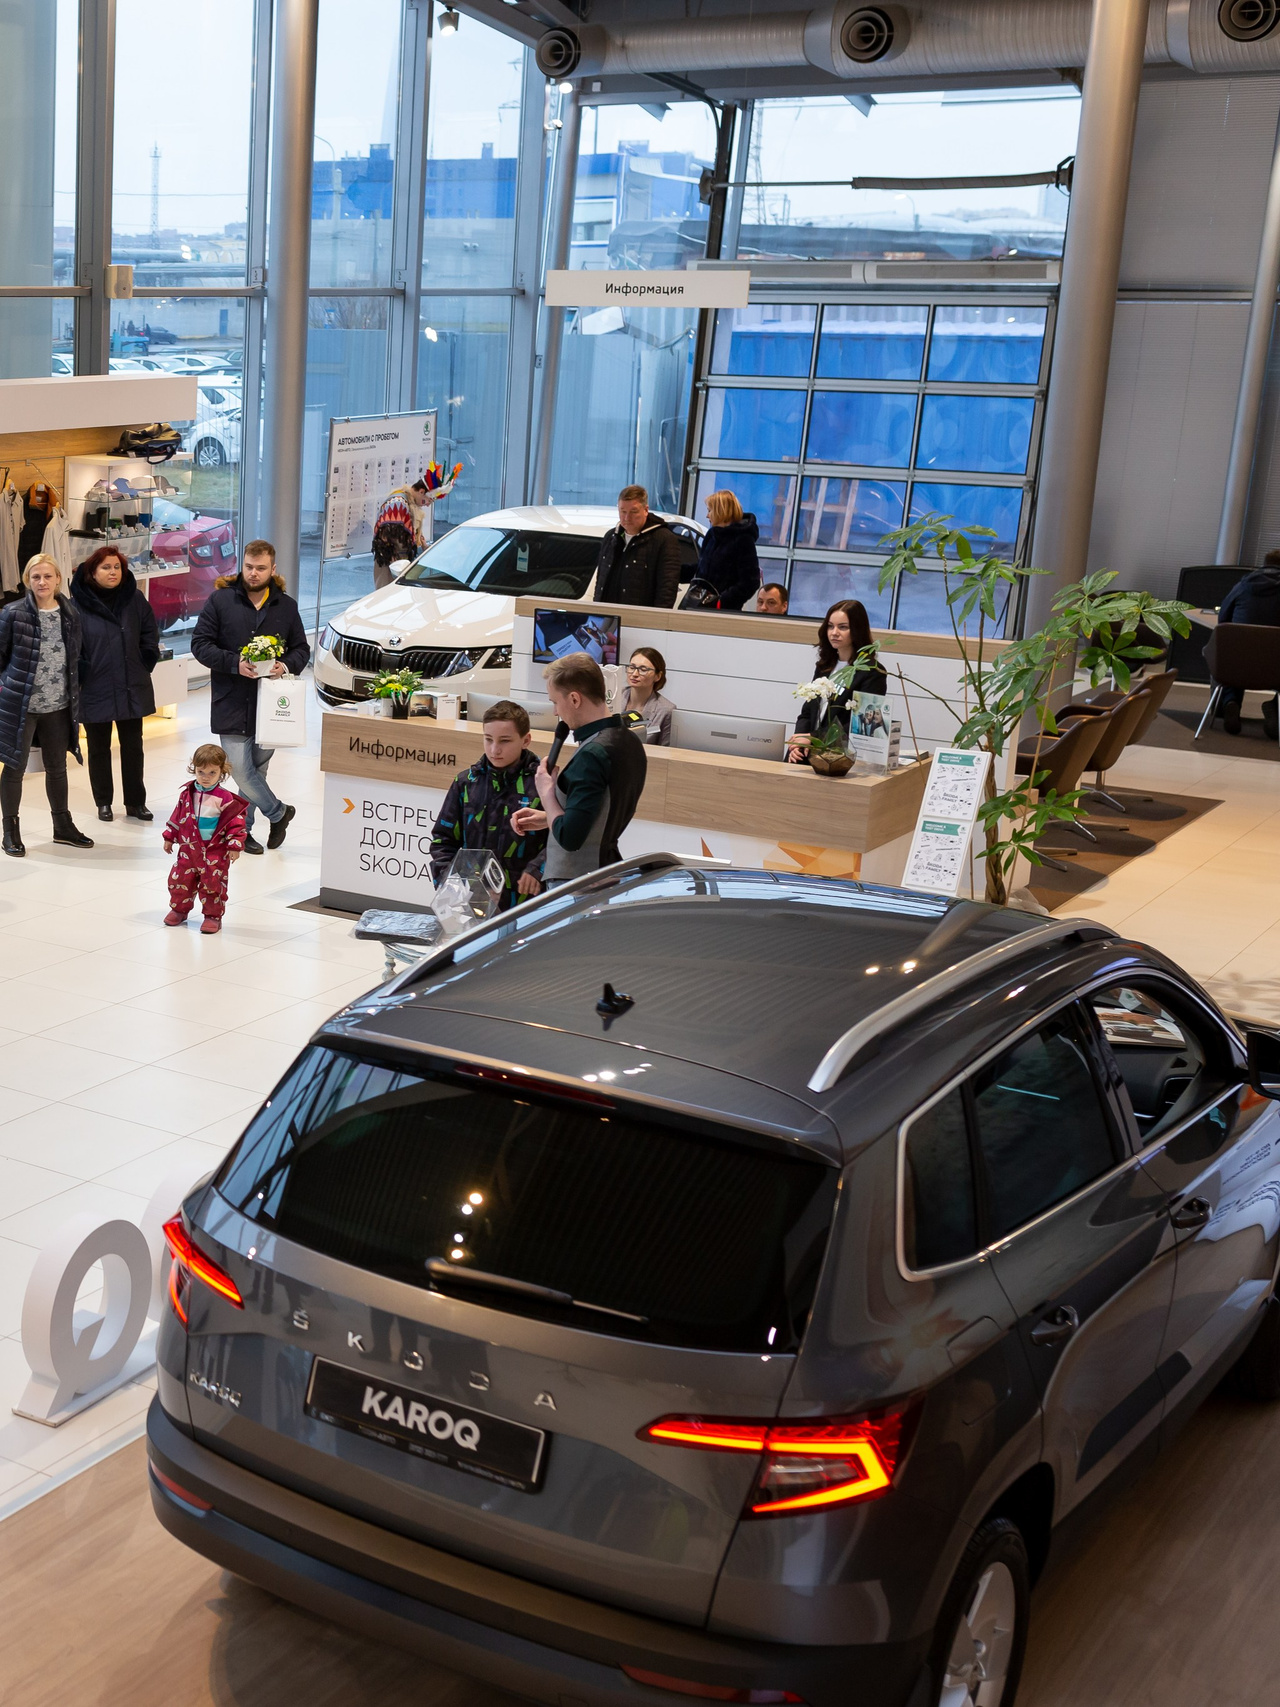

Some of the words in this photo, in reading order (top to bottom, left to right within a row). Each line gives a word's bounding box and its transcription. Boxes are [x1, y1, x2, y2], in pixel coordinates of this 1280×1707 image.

[605, 282, 684, 296] Информация
[338, 435, 371, 446] АВТОМОБИЛИ
[375, 432, 399, 442] ПРОБЕГОМ
[349, 736, 457, 767] Информация
[746, 735, 773, 744] Lenovo
[359, 853, 432, 882] SKODA
[188, 1368, 244, 1409] KAROQ
[361, 1385, 481, 1452] KAROQ
